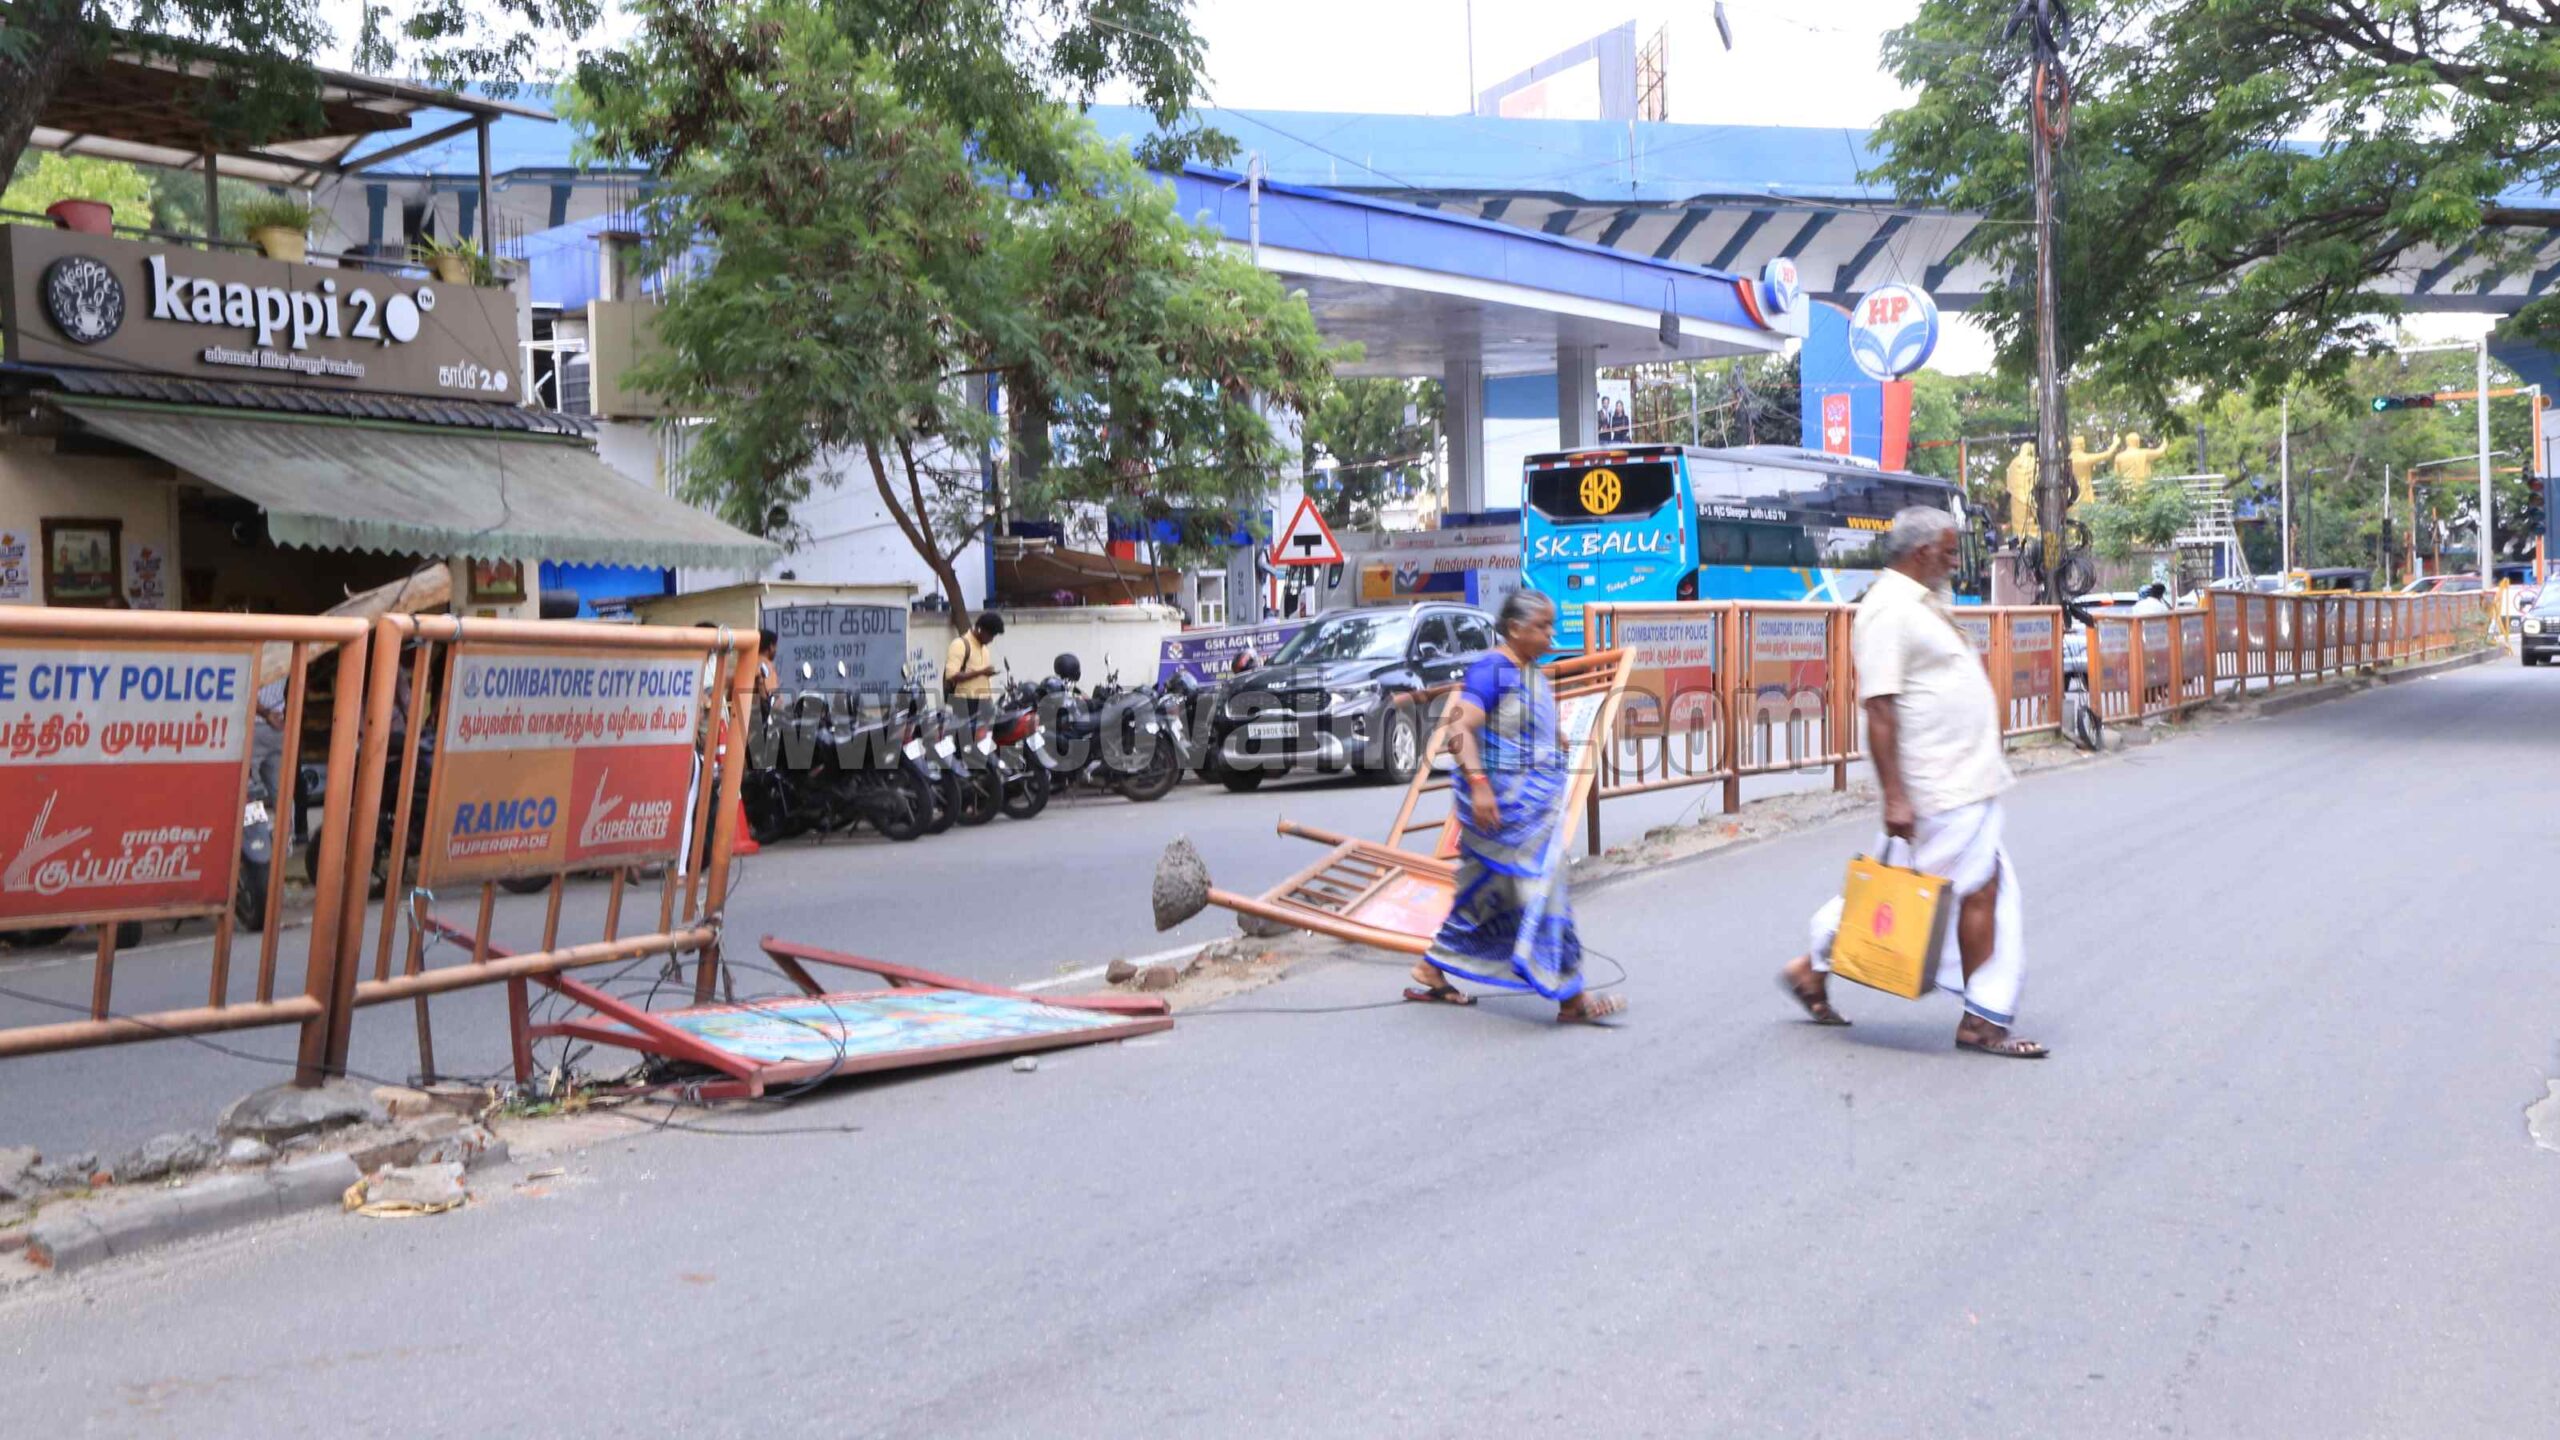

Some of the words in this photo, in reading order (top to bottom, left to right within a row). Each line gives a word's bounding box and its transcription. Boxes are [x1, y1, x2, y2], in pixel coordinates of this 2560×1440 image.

[1782, 267, 1794, 283] HP
[150, 254, 342, 349] kaappi
[1868, 296, 1909, 325] HP
[1433, 557, 1483, 573] Hindustan
[1205, 636, 1226, 650] GSK
[1626, 625, 1667, 642] COIMBATORE
[1668, 625, 1684, 641] CITY
[1685, 624, 1708, 640] POLICE
[29, 663, 110, 702] CITY
[119, 665, 237, 702] POLICE
[484, 667, 595, 698] COIMBATORE
[598, 668, 635, 698] CITY
[638, 668, 693, 697] POLICE
[101, 711, 229, 755] முடியும்!!
[453, 796, 558, 835] RAMCO
[628, 800, 672, 817] RAMCO
[594, 817, 669, 842] SUPERCRETE
[451, 833, 550, 857] SUPERGRADE
